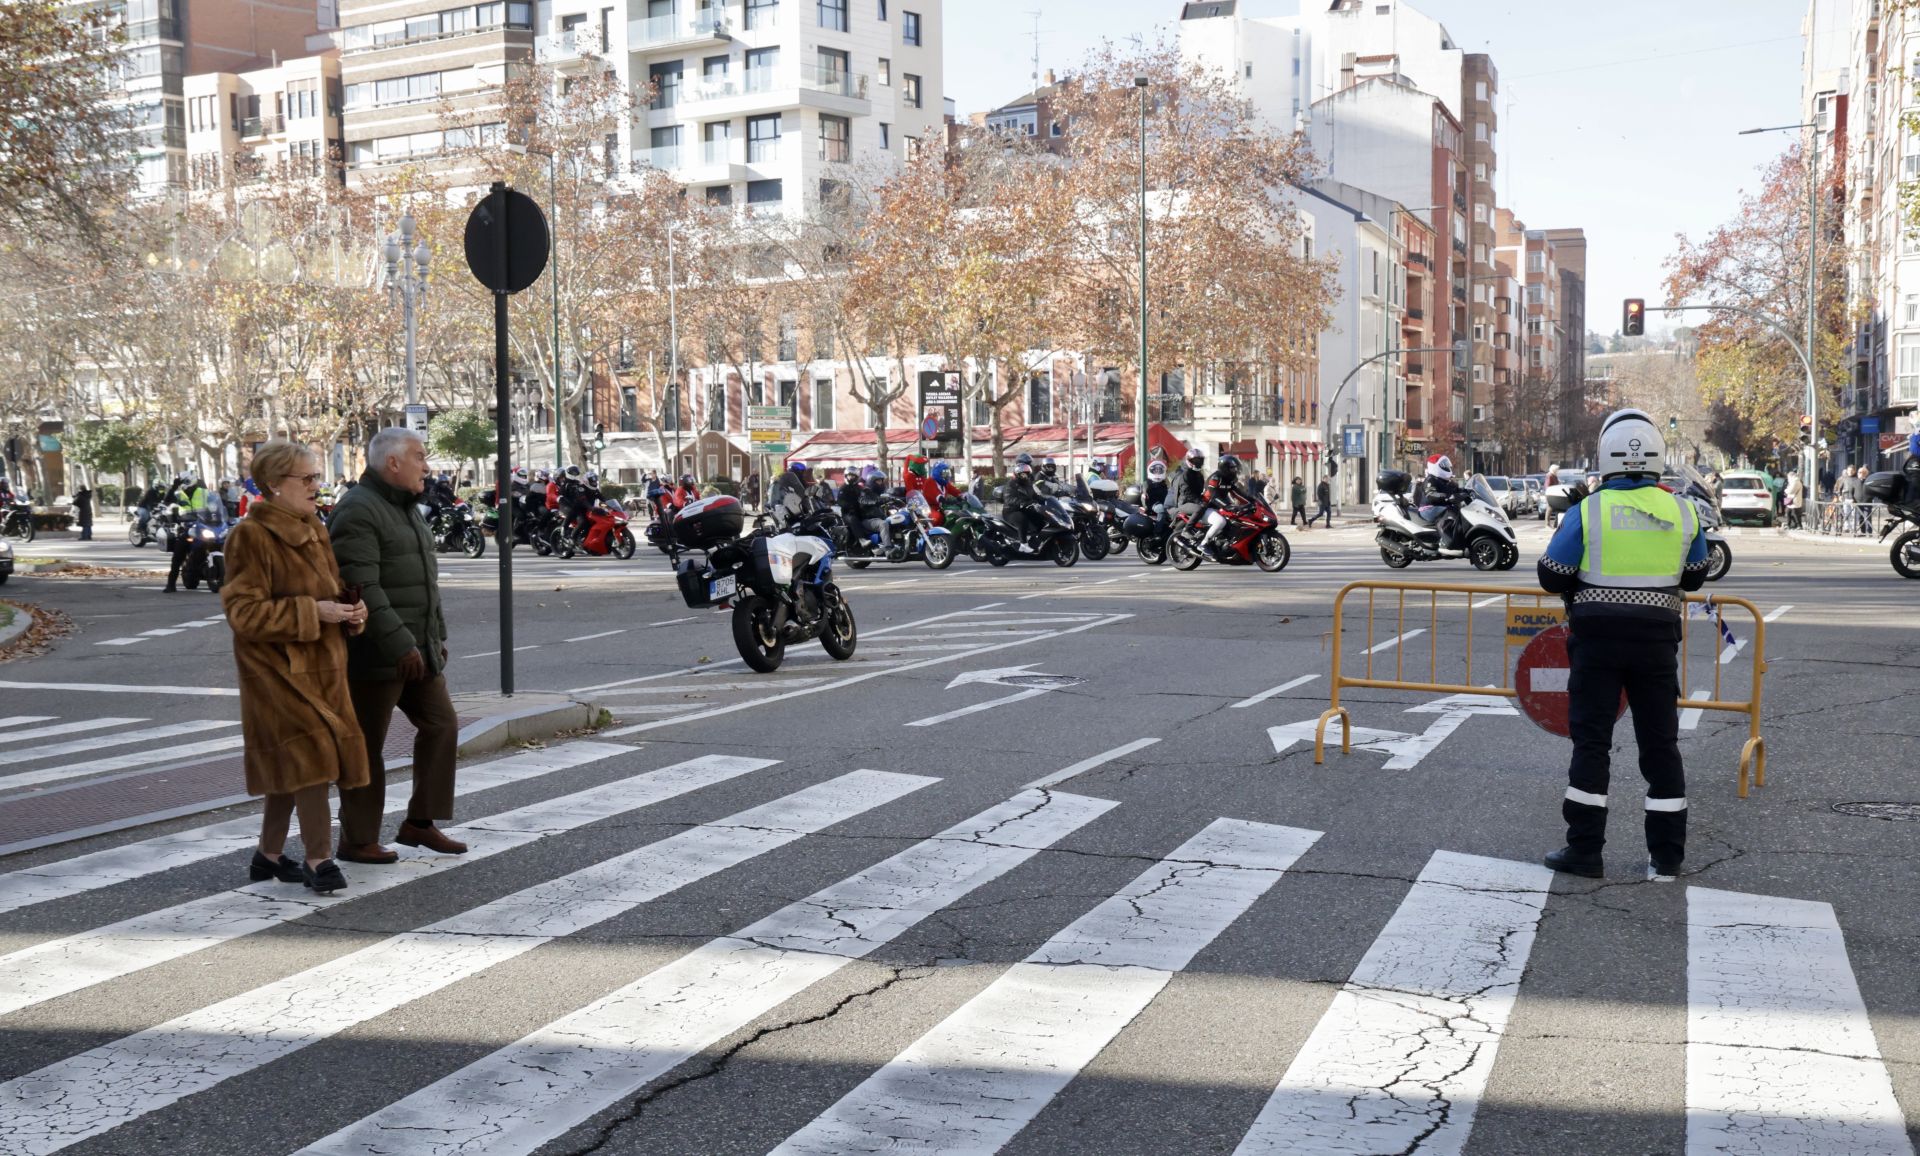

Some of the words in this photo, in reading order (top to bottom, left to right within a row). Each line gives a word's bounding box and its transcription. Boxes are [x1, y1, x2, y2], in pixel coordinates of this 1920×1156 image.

[1345, 429, 1361, 445] T
[716, 576, 735, 587] 8705
[716, 586, 730, 597] KHL
[1514, 612, 1558, 625] POLICÍA
